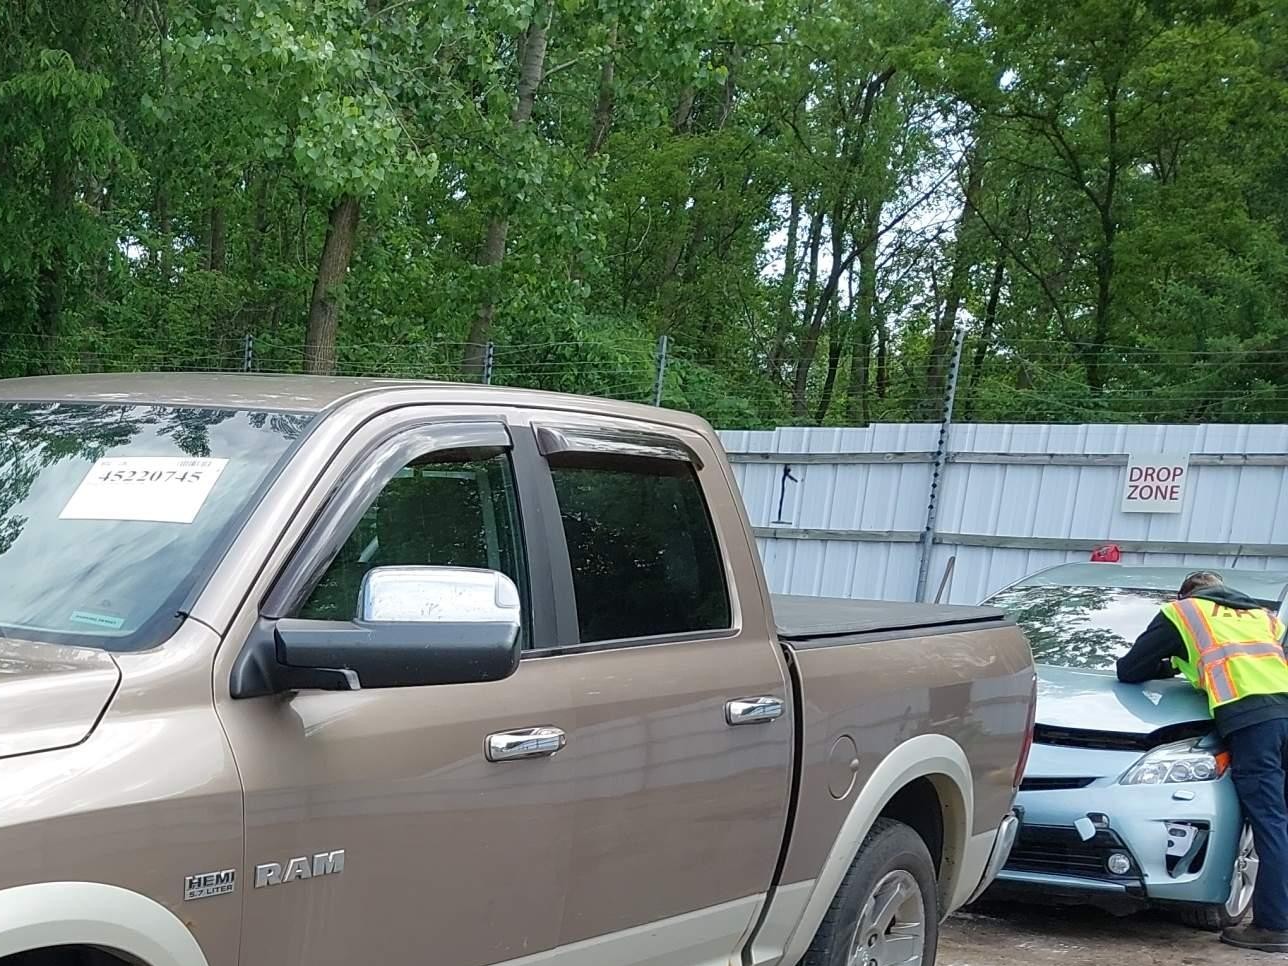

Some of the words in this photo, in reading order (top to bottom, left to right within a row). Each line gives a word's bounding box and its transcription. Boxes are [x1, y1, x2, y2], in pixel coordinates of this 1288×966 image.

[99, 470, 203, 483] 45220745
[1129, 467, 1184, 482] DROP
[1126, 485, 1180, 500] ZONE
[254, 850, 345, 889] RAM
[188, 871, 235, 889] HEMI
[189, 889, 204, 898] 5.7
[206, 884, 233, 895] LITER
